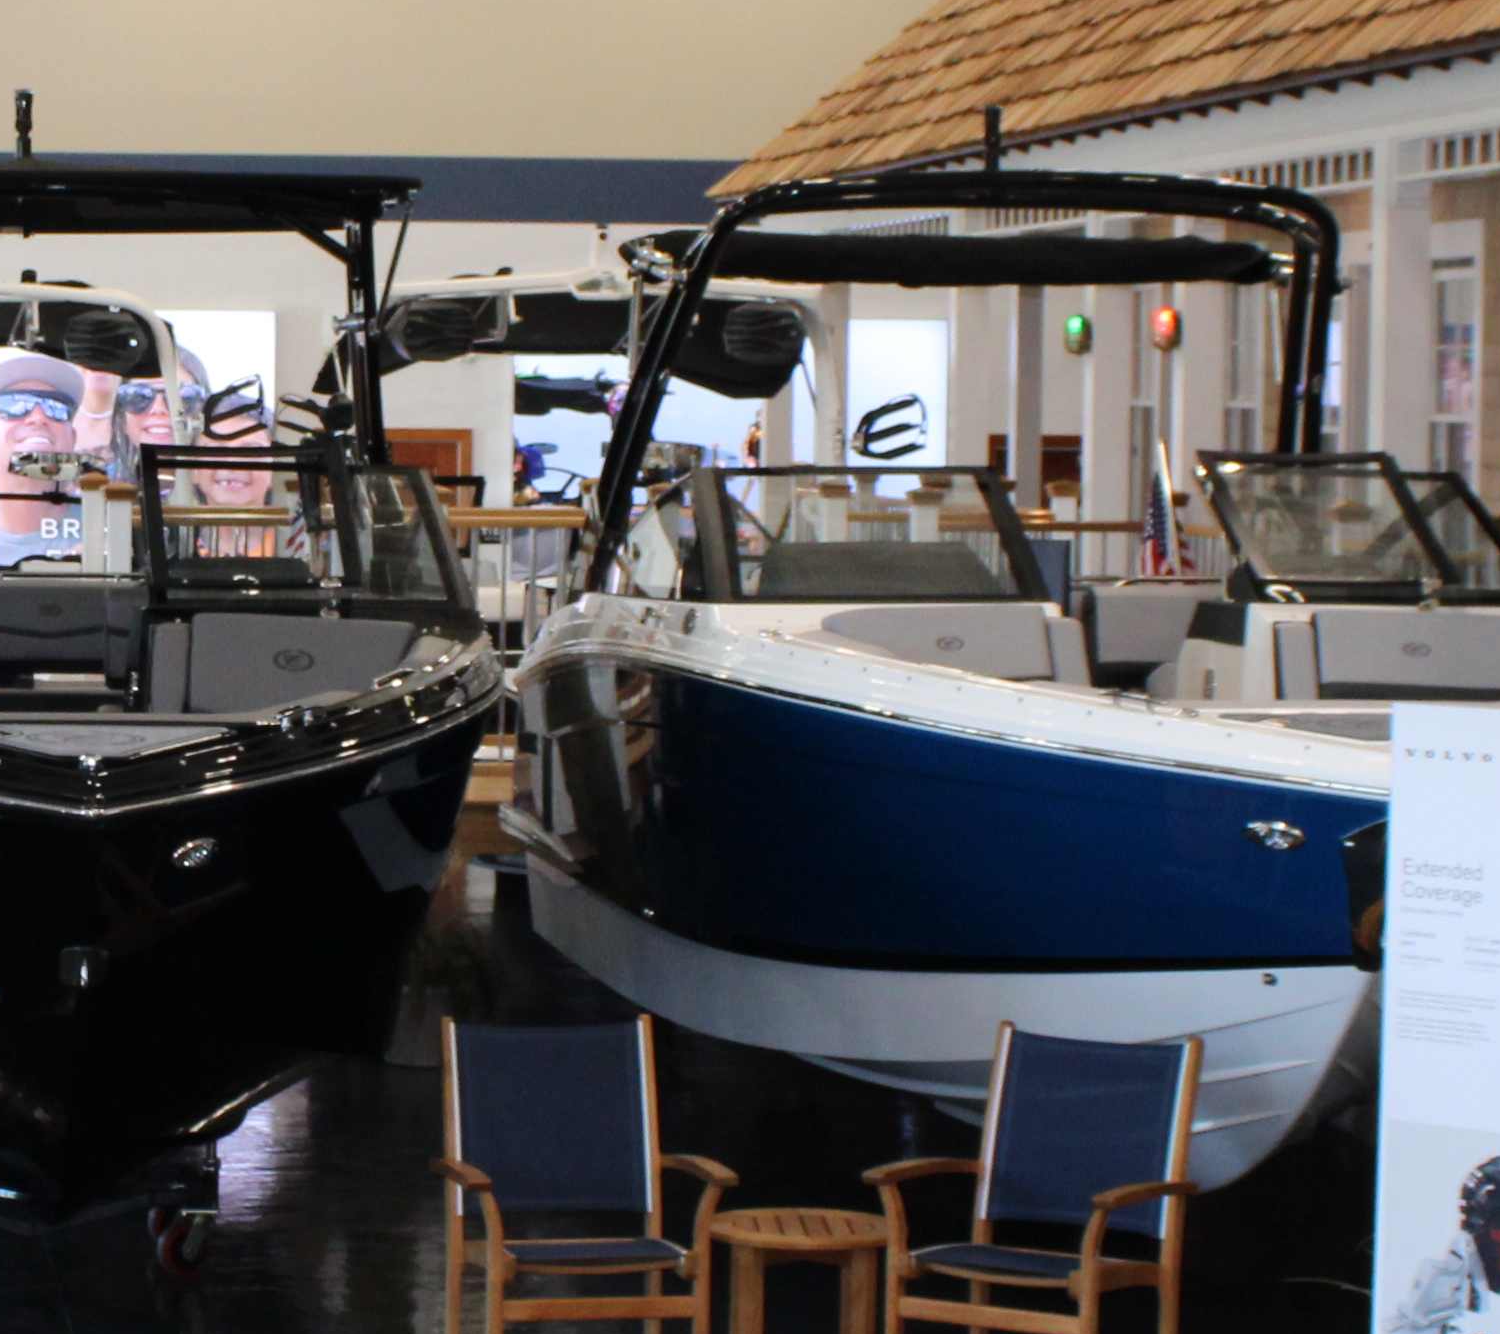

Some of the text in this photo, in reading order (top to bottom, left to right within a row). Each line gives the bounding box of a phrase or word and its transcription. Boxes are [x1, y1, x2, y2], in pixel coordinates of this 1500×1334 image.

[1404, 747, 1493, 763] VOLVO
[1401, 856, 1484, 881] Extended
[1400, 880, 1484, 908] Coverage
